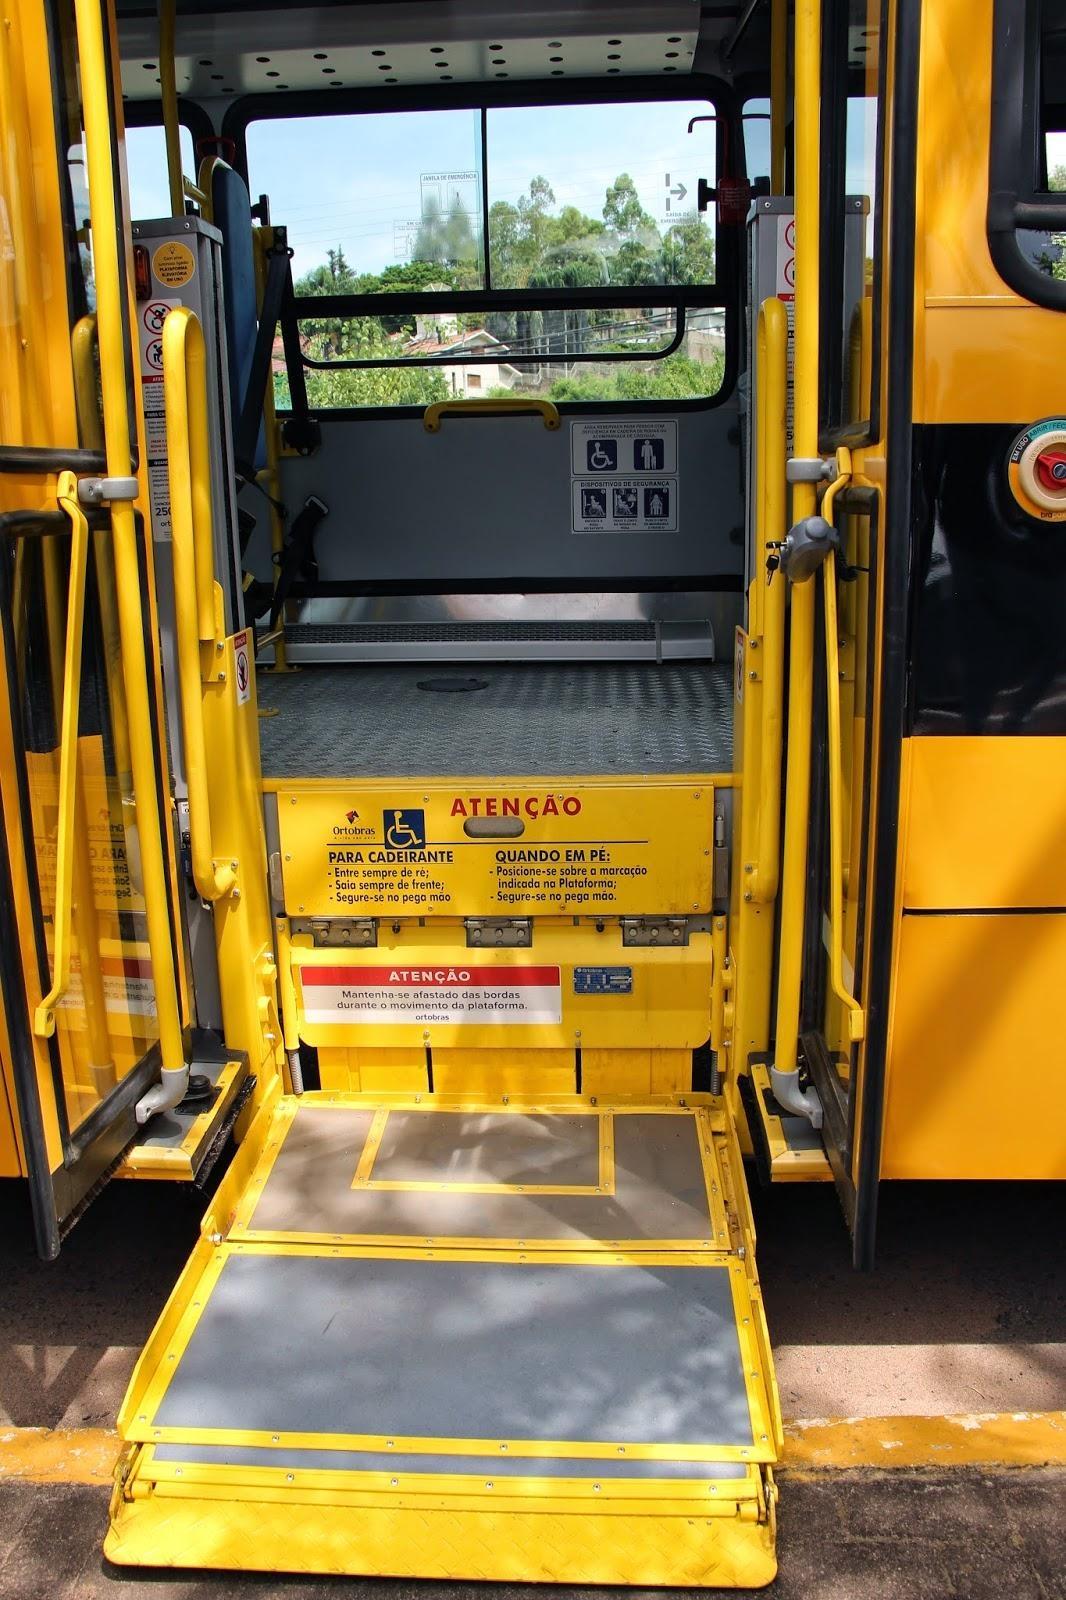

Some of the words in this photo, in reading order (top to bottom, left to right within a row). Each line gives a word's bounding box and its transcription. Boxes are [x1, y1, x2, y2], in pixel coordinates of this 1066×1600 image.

[1052, 422, 1066, 430] FEC
[1012, 450, 1020, 461] EM
[1017, 436, 1029, 451] USO
[451, 795, 582, 819] ATENÇÃO
[333, 826, 376, 835] Ortobras
[329, 852, 364, 863] PARA
[368, 851, 454, 863] CADEIRANTE
[495, 850, 561, 863] QUANDO
[565, 850, 585, 861] EM
[590, 846, 611, 861] PÉ:
[334, 868, 359, 877] Entre
[362, 868, 398, 879] sempre
[401, 867, 412, 877] de
[497, 866, 557, 876] Posicione-se
[560, 865, 587, 876] sobre
[600, 865, 647, 878] marcação
[335, 880, 356, 889] Saia
[359, 880, 394, 891] sempre
[398, 879, 409, 889] de
[412, 879, 445, 891] frente;
[498, 878, 540, 889] indicada
[543, 880, 556, 888] na
[559, 878, 617, 889] Plataforma;
[336, 892, 384, 904] Segure-se
[388, 893, 399, 902] no
[403, 894, 426, 904] pega
[430, 891, 451, 902] mão
[497, 891, 546, 903] Segure-se
[550, 893, 561, 901] no
[565, 893, 589, 903] pega
[593, 891, 617, 901] mão.
[388, 969, 471, 986] ATENÇÃO
[342, 990, 410, 1000] Mantenha-se
[413, 990, 458, 1000] afastado
[462, 990, 481, 999] das
[483, 990, 520, 999] bordas
[336, 1001, 377, 1010] durante
[390, 1001, 449, 1010] movimento
[451, 1001, 465, 1010] da
[468, 1001, 528, 1011] plataforma.
[415, 1013, 450, 1022] ortobras
